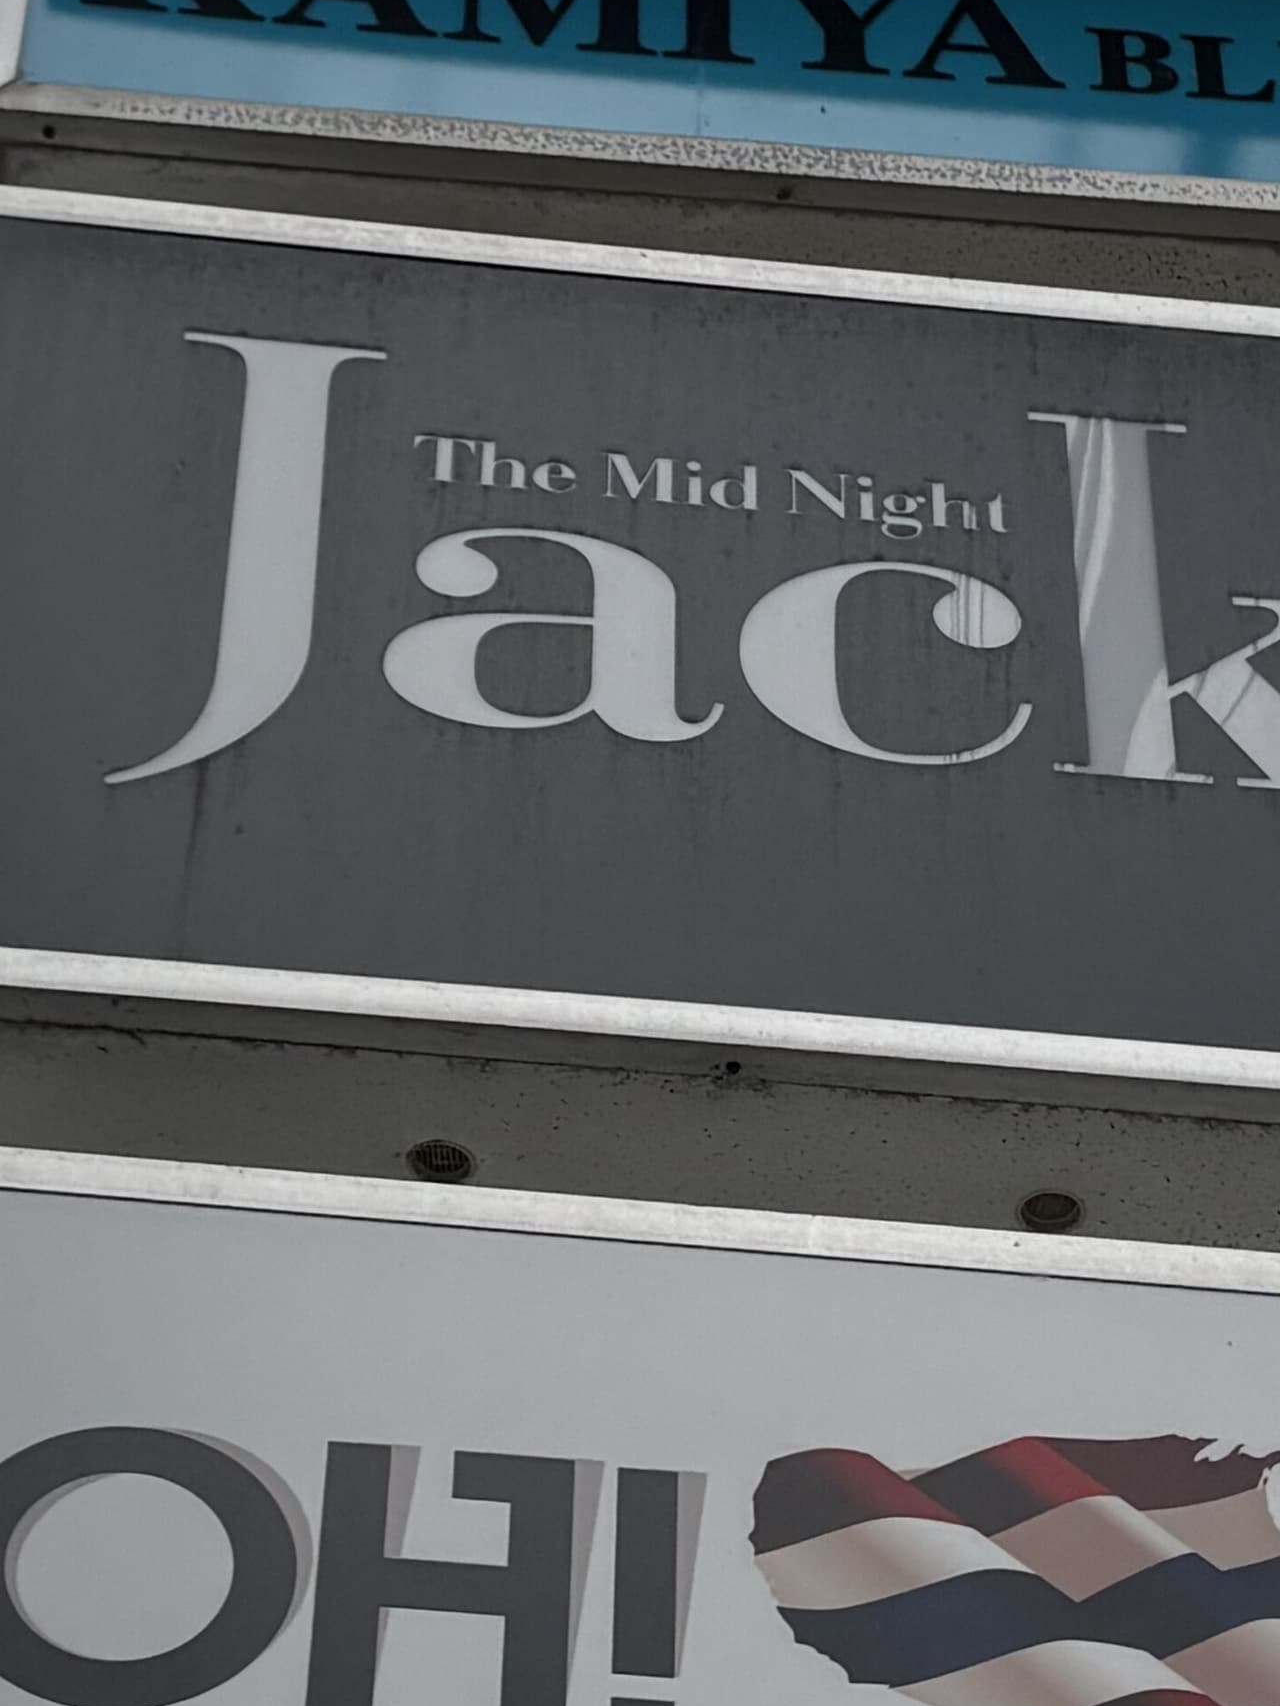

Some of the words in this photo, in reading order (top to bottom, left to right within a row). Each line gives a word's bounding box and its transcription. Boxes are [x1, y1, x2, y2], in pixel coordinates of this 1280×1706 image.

[414, 434, 577, 496] The
[604, 453, 760, 513] Mid
[786, 468, 1012, 537] Night
